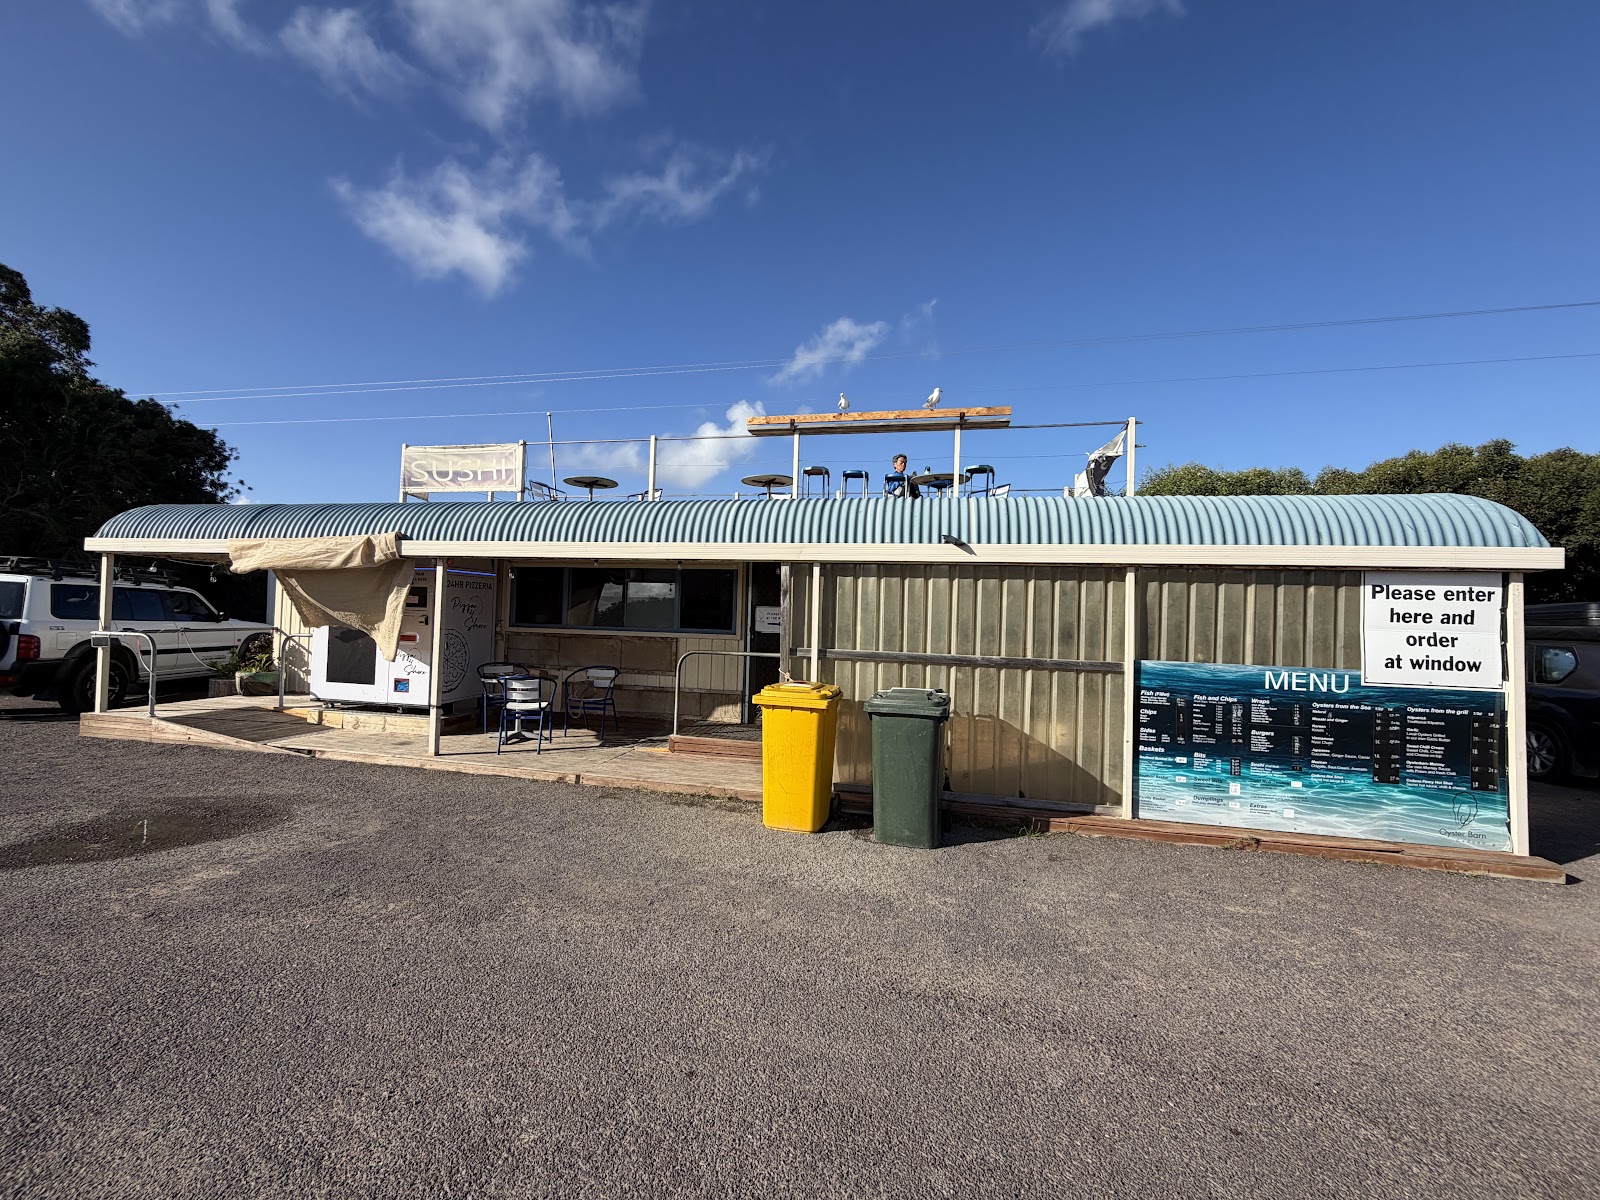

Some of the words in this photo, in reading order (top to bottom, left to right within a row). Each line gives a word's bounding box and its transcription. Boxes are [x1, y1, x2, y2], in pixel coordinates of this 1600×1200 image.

[410, 459, 506, 482] SUSHI
[447, 580, 464, 588] 24HR
[466, 582, 492, 590] PIZZERIA
[1371, 584, 1436, 601] Please
[1443, 587, 1495, 602] enter
[451, 596, 478, 614] Pizza
[1390, 608, 1433, 624] here
[1440, 610, 1475, 625] and
[1406, 632, 1458, 647] order
[1384, 655, 1402, 669] at
[1410, 655, 1482, 672] window
[1264, 670, 1349, 693] MENU
[1439, 828, 1465, 837] Oyster
[1468, 831, 1486, 839] Barn
